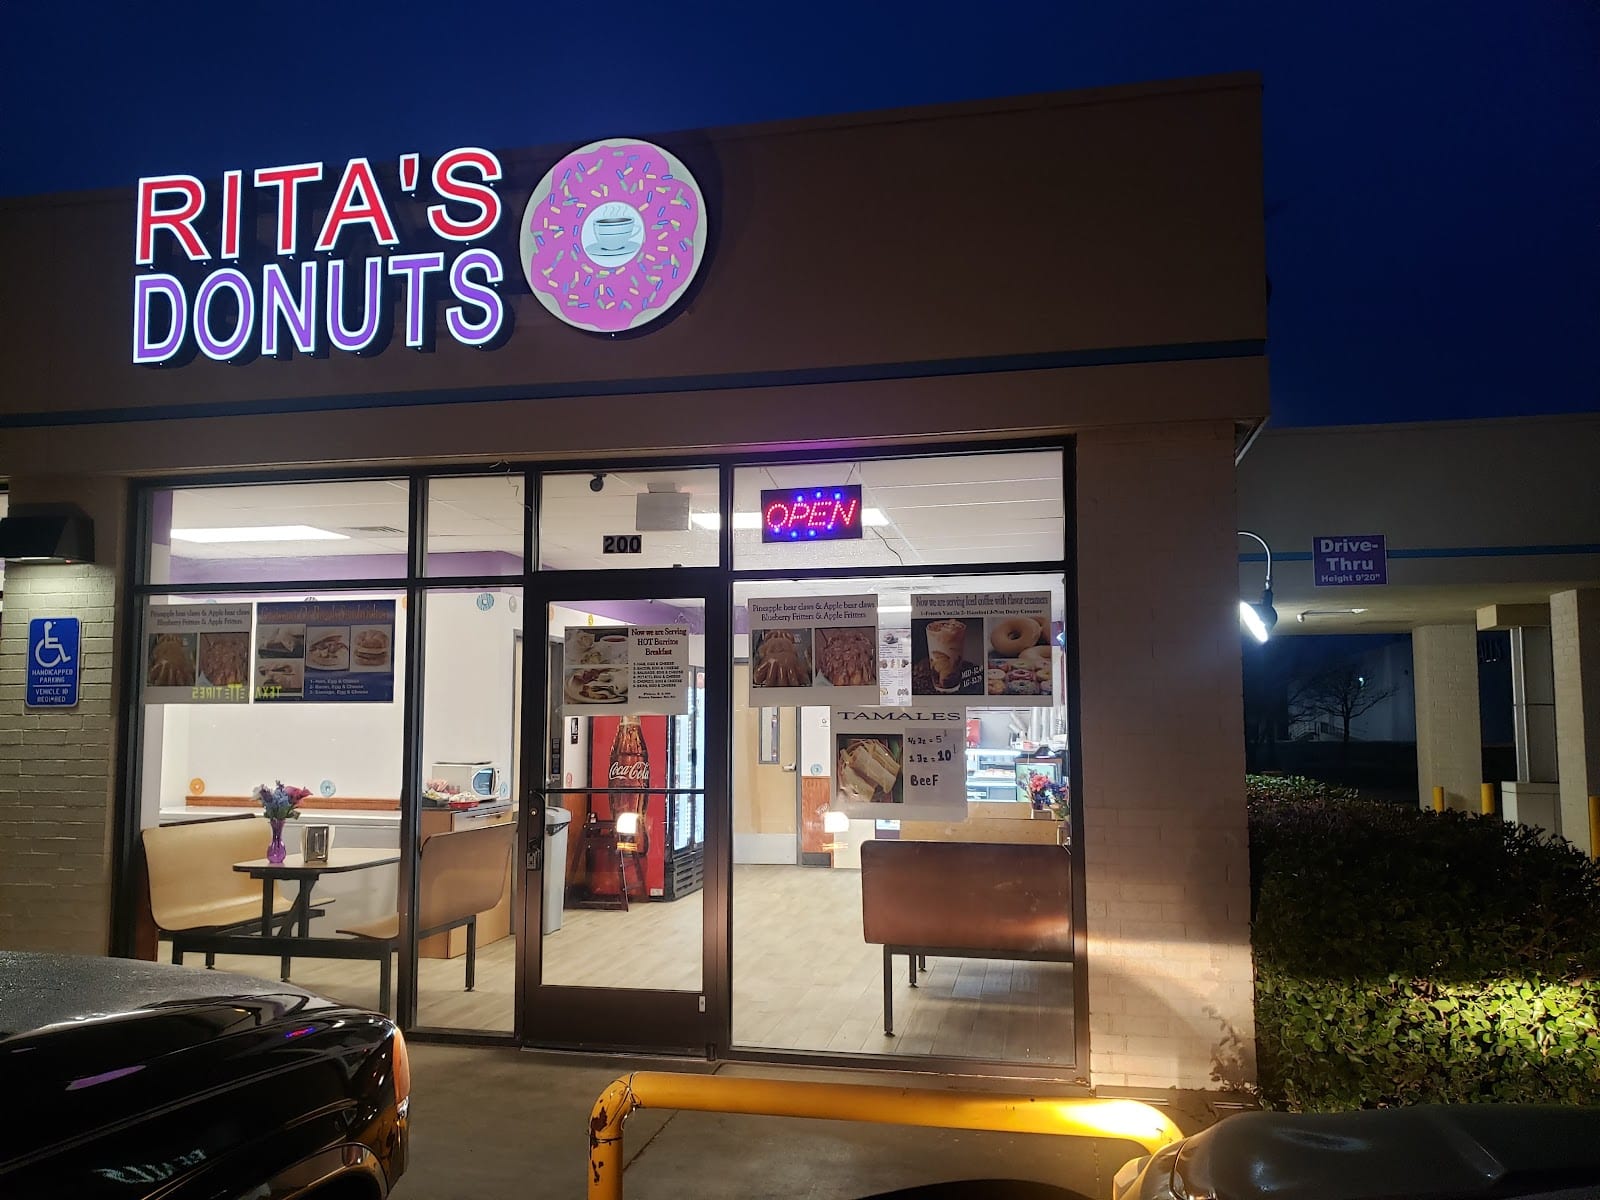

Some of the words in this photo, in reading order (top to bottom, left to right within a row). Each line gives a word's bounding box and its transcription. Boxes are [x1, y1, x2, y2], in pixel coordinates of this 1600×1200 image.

[136, 146, 502, 265] RITA'S
[132, 248, 503, 364] DONUTS
[765, 499, 857, 528] OPEN
[604, 535, 641, 553] 200
[1320, 538, 1378, 553] Drive-
[1326, 557, 1374, 571] Thru
[1321, 574, 1353, 583] Height
[752, 603, 783, 613] Pineapple
[783, 603, 797, 611] bear
[798, 603, 814, 611] claws
[815, 602, 822, 610] &
[823, 602, 842, 611] Apple
[843, 601, 857, 609] bear
[761, 613, 791, 622] Blueberry
[815, 612, 822, 620] &
[823, 611, 843, 620] Apple
[843, 610, 866, 619] Fritters
[631, 628, 645, 636] Now
[664, 627, 687, 636] Serving
[637, 638, 654, 646] HOT
[645, 647, 672, 656] Breakfast
[31, 668, 74, 676] HANDICAPPED
[39, 676, 65, 684] PARKING
[35, 688, 60, 696] VEHICLE
[837, 711, 961, 721] TAMALES
[935, 735, 943, 743] 5
[937, 749, 952, 762] 10
